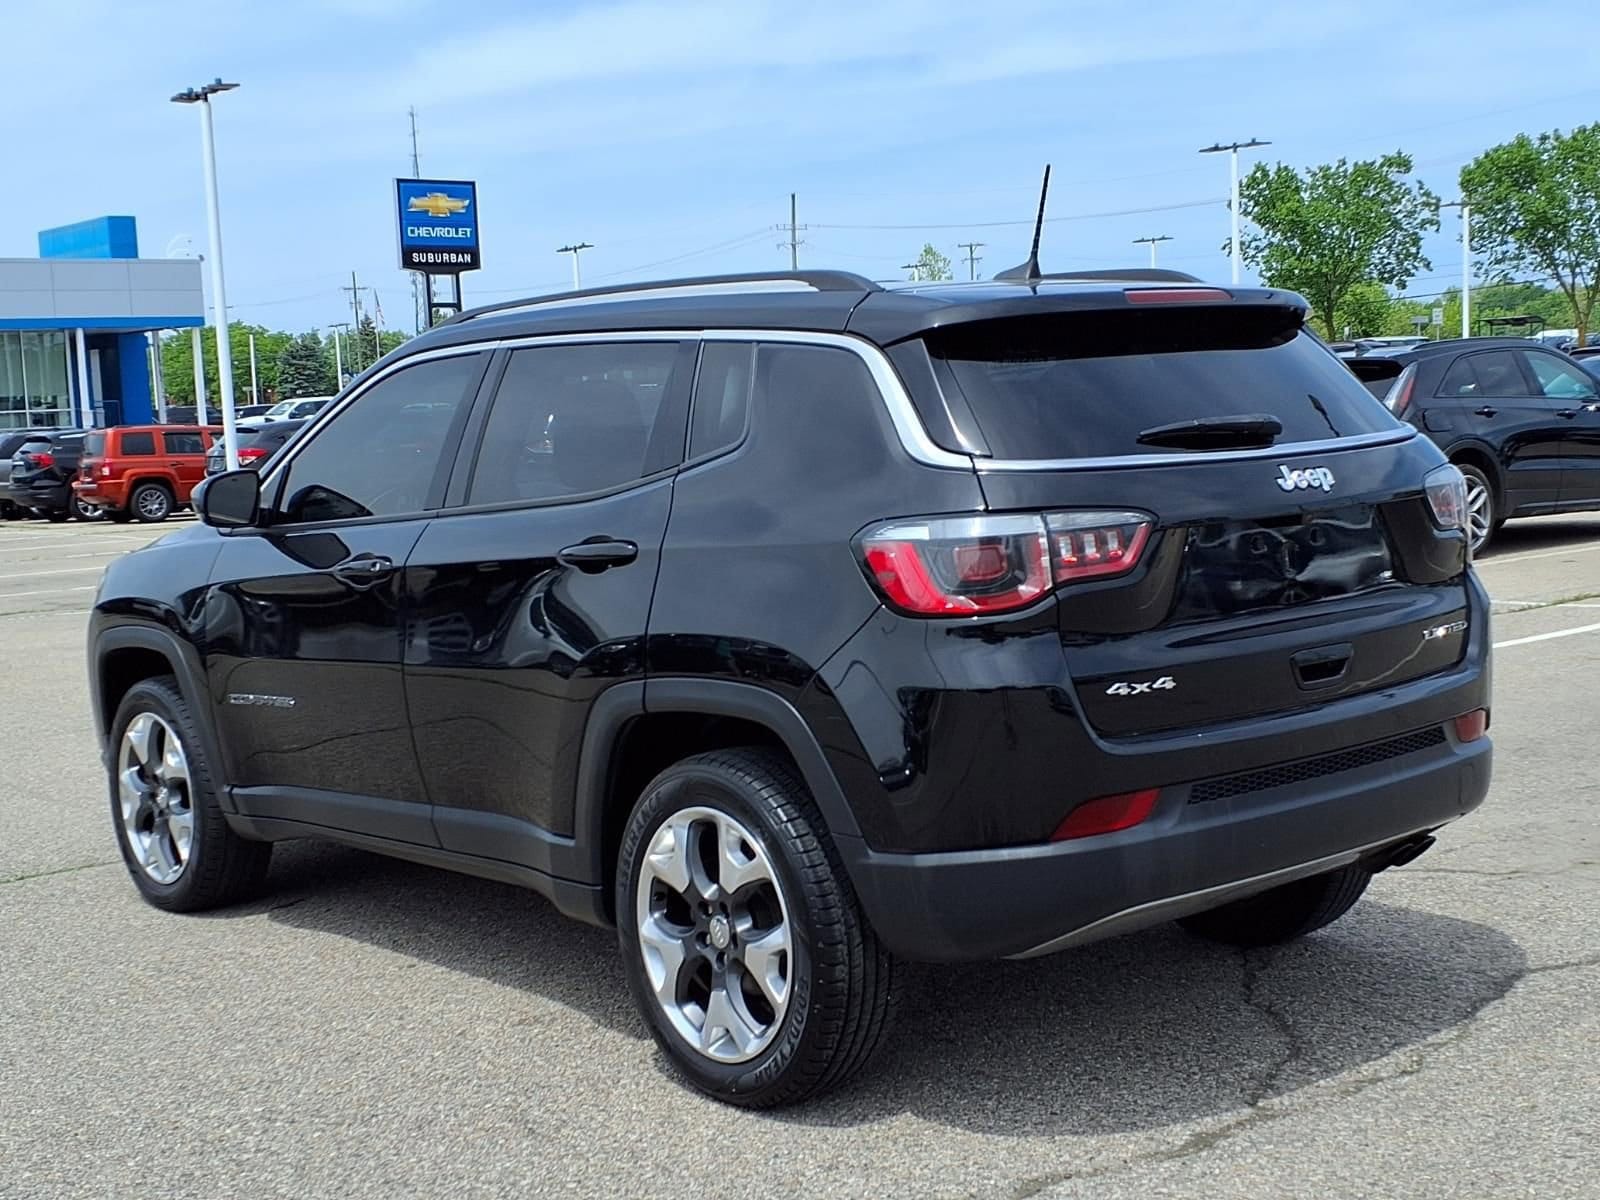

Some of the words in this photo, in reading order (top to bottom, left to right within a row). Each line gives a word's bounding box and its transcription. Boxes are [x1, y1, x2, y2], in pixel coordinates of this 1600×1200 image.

[407, 226, 472, 238] CHEVROLET
[412, 252, 472, 263] SUBURBAN
[1276, 464, 1336, 492] Jeep
